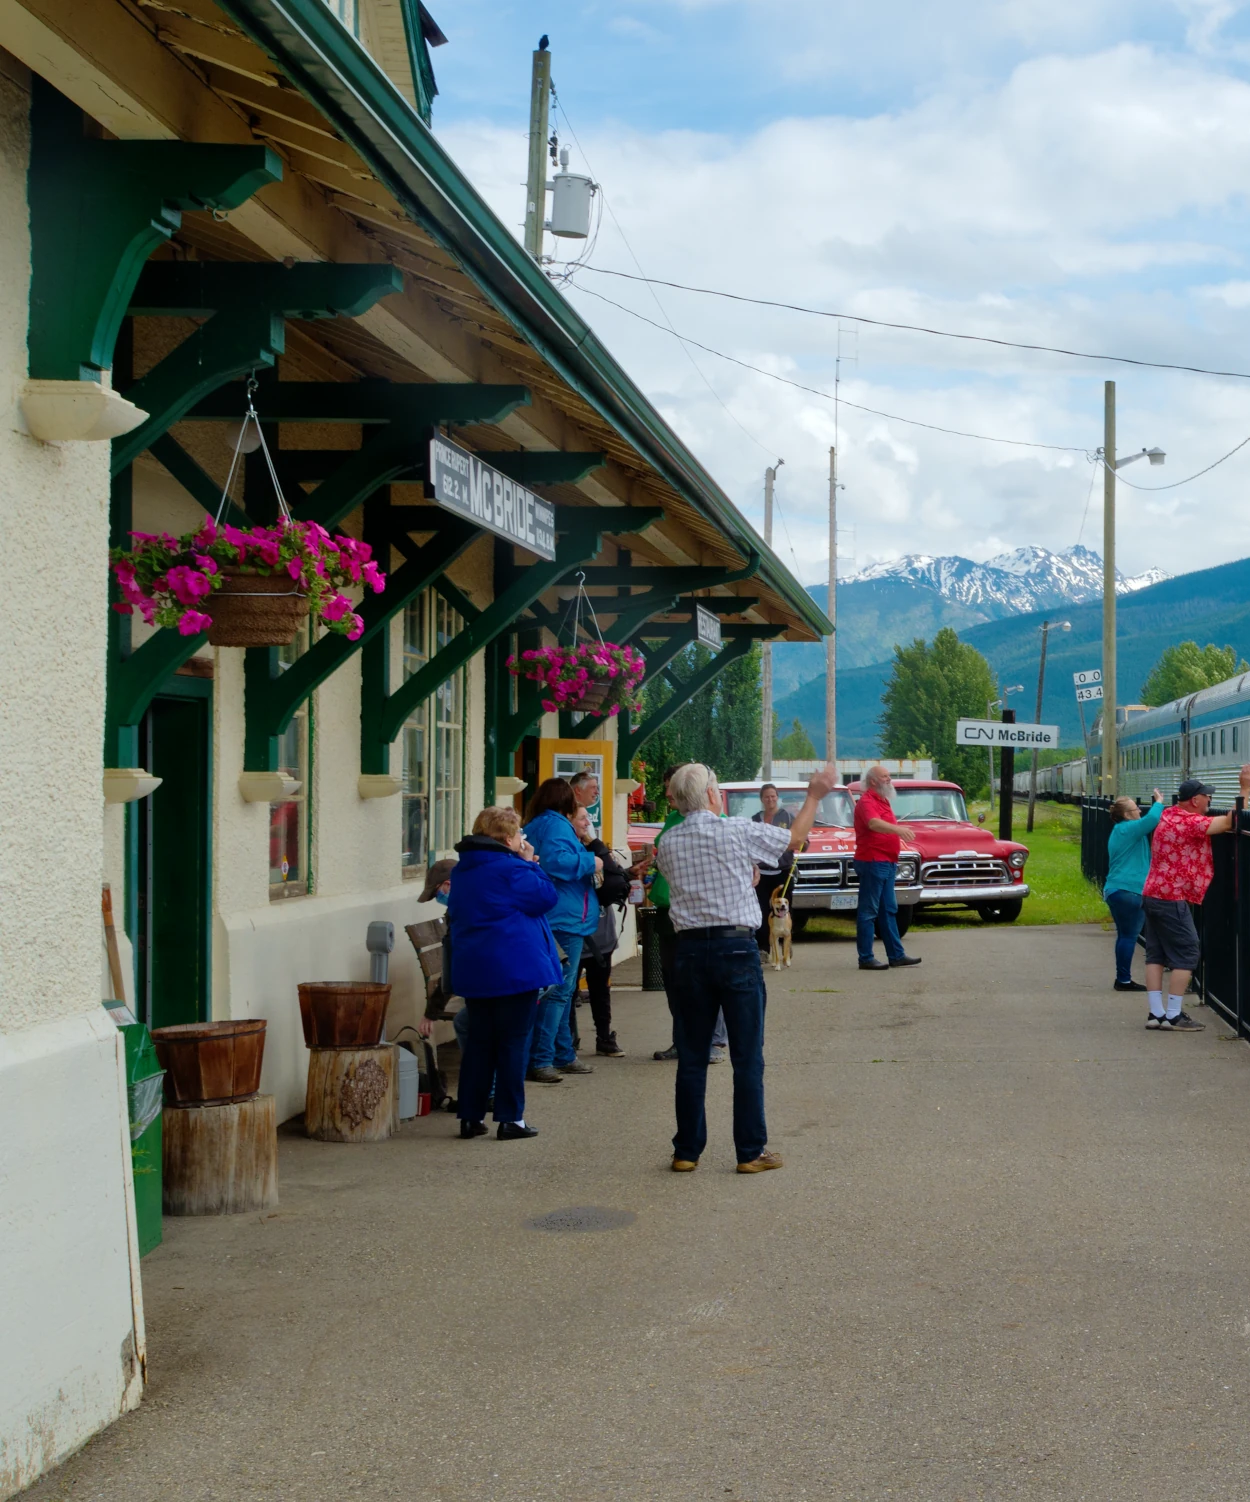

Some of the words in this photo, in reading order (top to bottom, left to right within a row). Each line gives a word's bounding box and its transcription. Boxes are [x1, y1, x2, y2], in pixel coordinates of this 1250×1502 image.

[1077, 687, 1103, 700] 43.4
[964, 727, 994, 740] CN
[998, 729, 1051, 743] McBride
